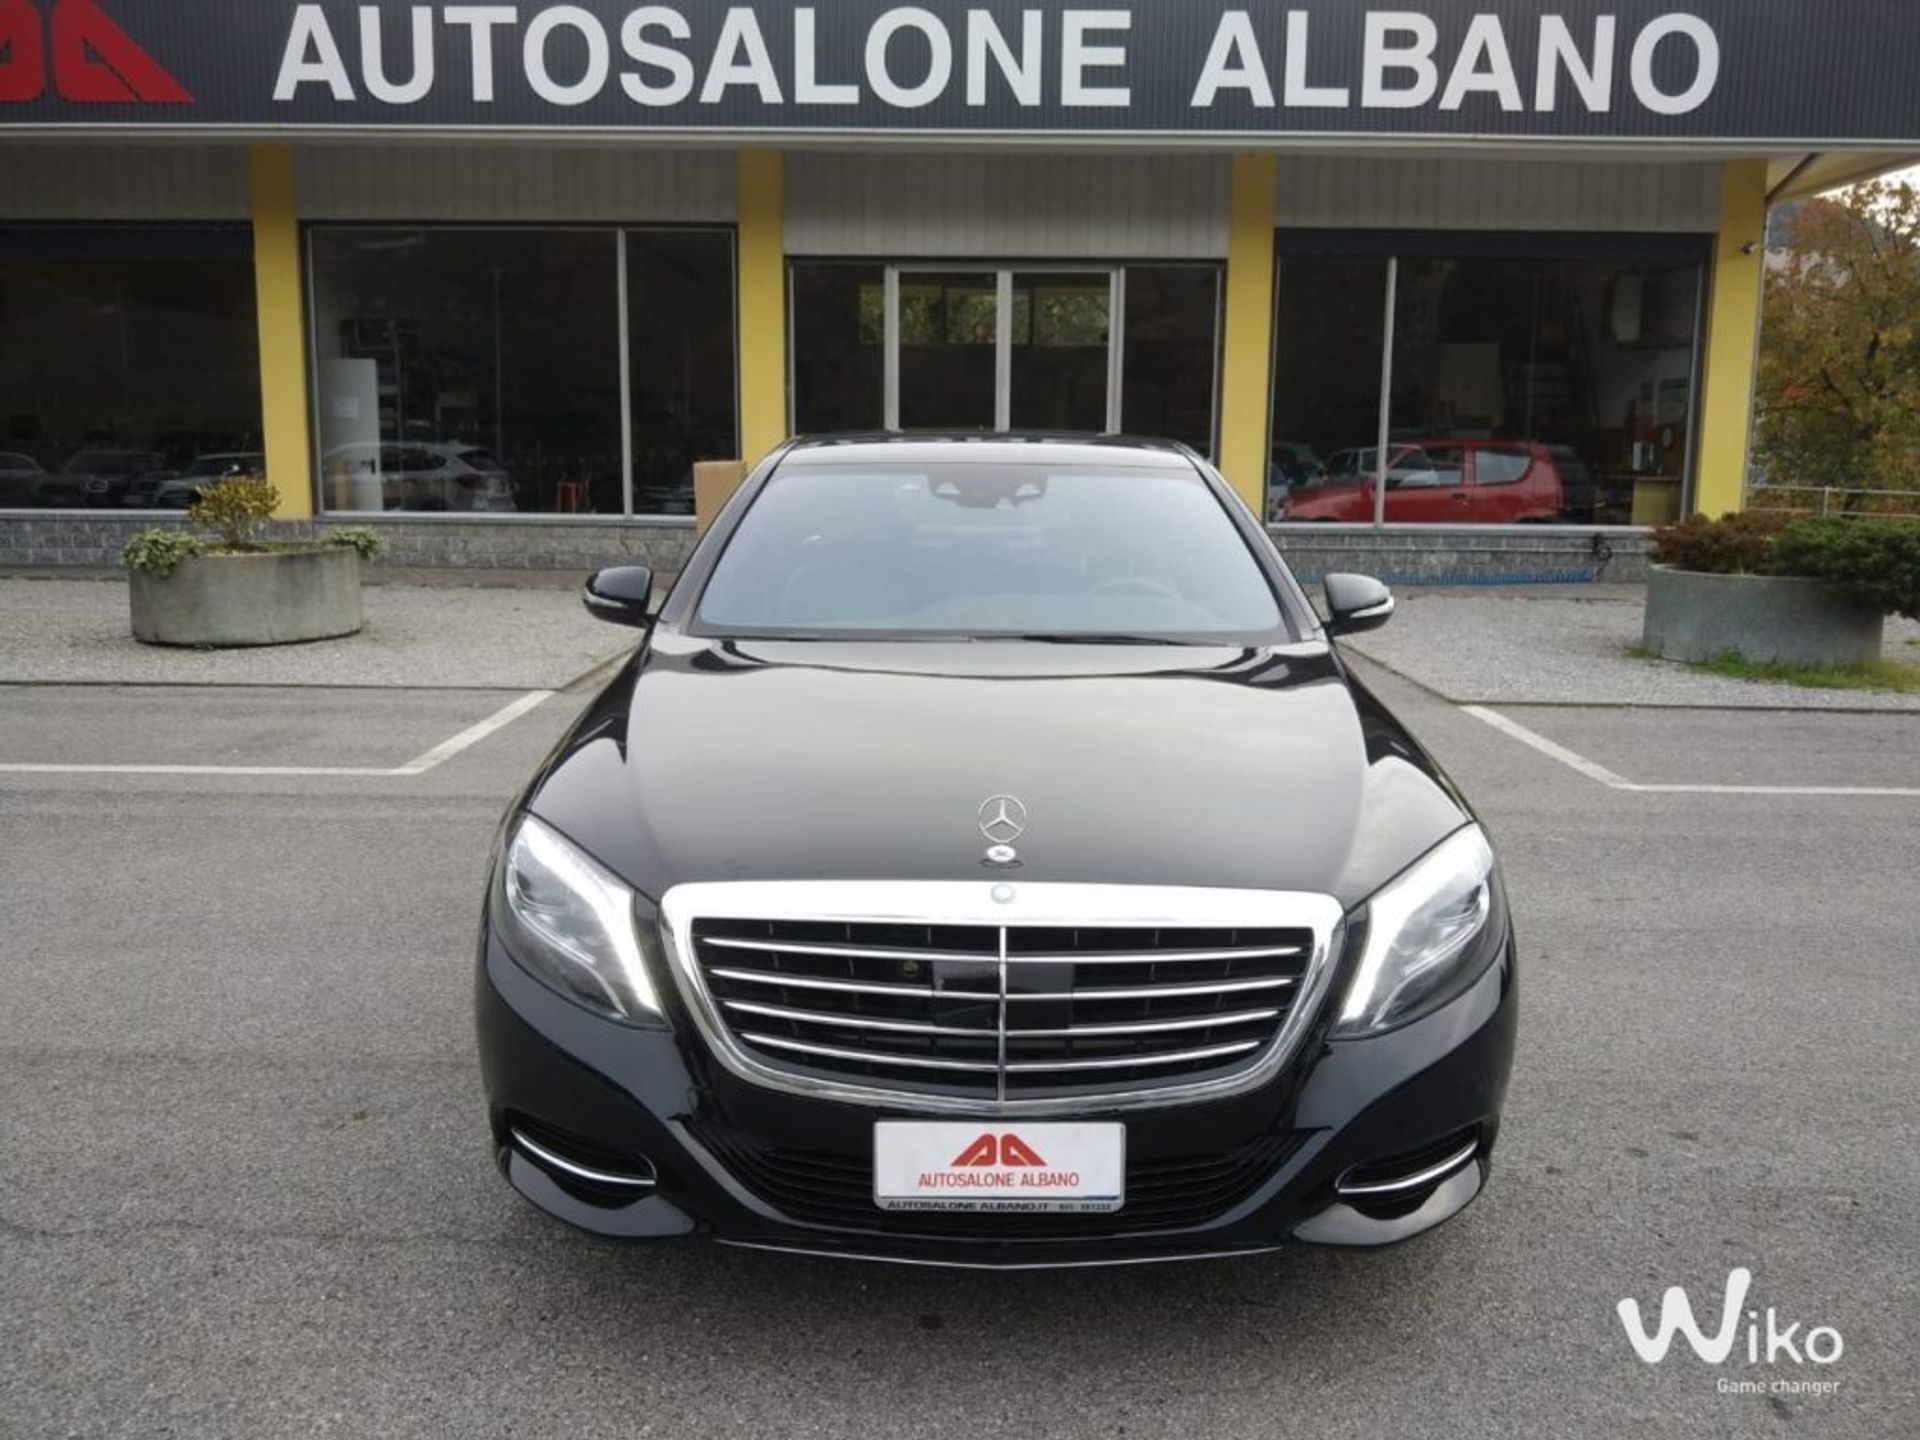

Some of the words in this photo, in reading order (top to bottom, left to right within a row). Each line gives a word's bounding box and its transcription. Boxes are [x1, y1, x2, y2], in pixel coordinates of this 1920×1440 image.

[273, 5, 1131, 107] AUTOSALONE
[1190, 10, 1720, 115] ALBANO
[918, 1172, 1015, 1188] AUTOSALONE
[1020, 1172, 1080, 1187] ALBANO
[887, 1200, 977, 1210] AUTOSALONE
